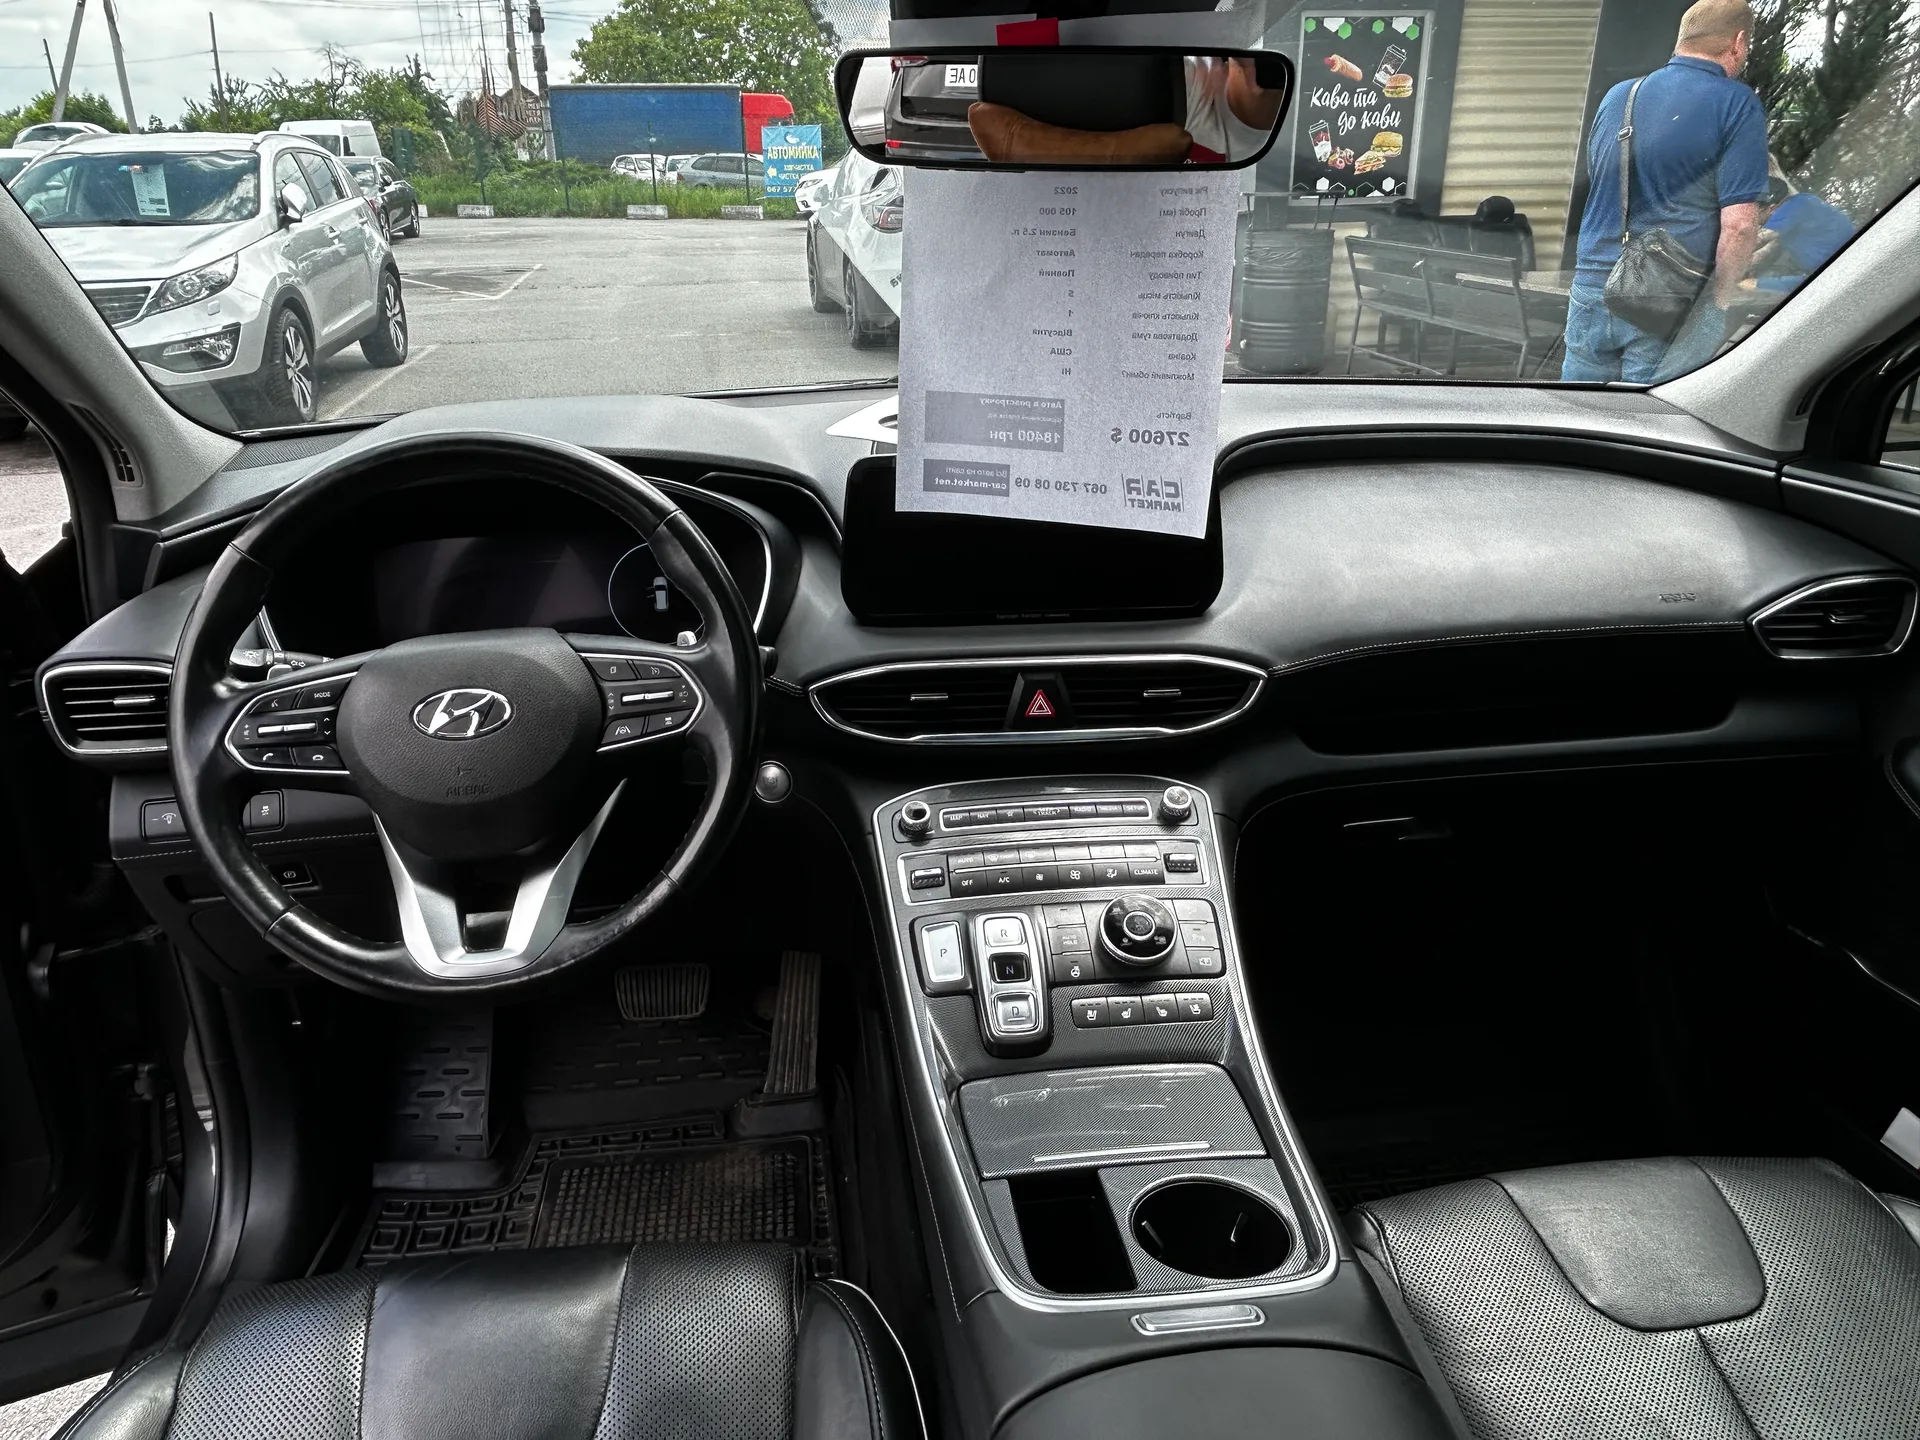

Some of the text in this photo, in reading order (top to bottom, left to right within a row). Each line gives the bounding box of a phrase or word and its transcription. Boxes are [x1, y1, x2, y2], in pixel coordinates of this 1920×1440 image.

[1310, 83, 1378, 109] Кава та
[1338, 104, 1401, 135] до кави
[768, 142, 819, 159] АВТОМИЙКА
[961, 879, 973, 887] OFF
[998, 876, 1010, 884] A/C
[1000, 928, 1008, 938] R
[940, 948, 947, 958] P
[1006, 964, 1014, 975] N
[1011, 1006, 1020, 1018] D
